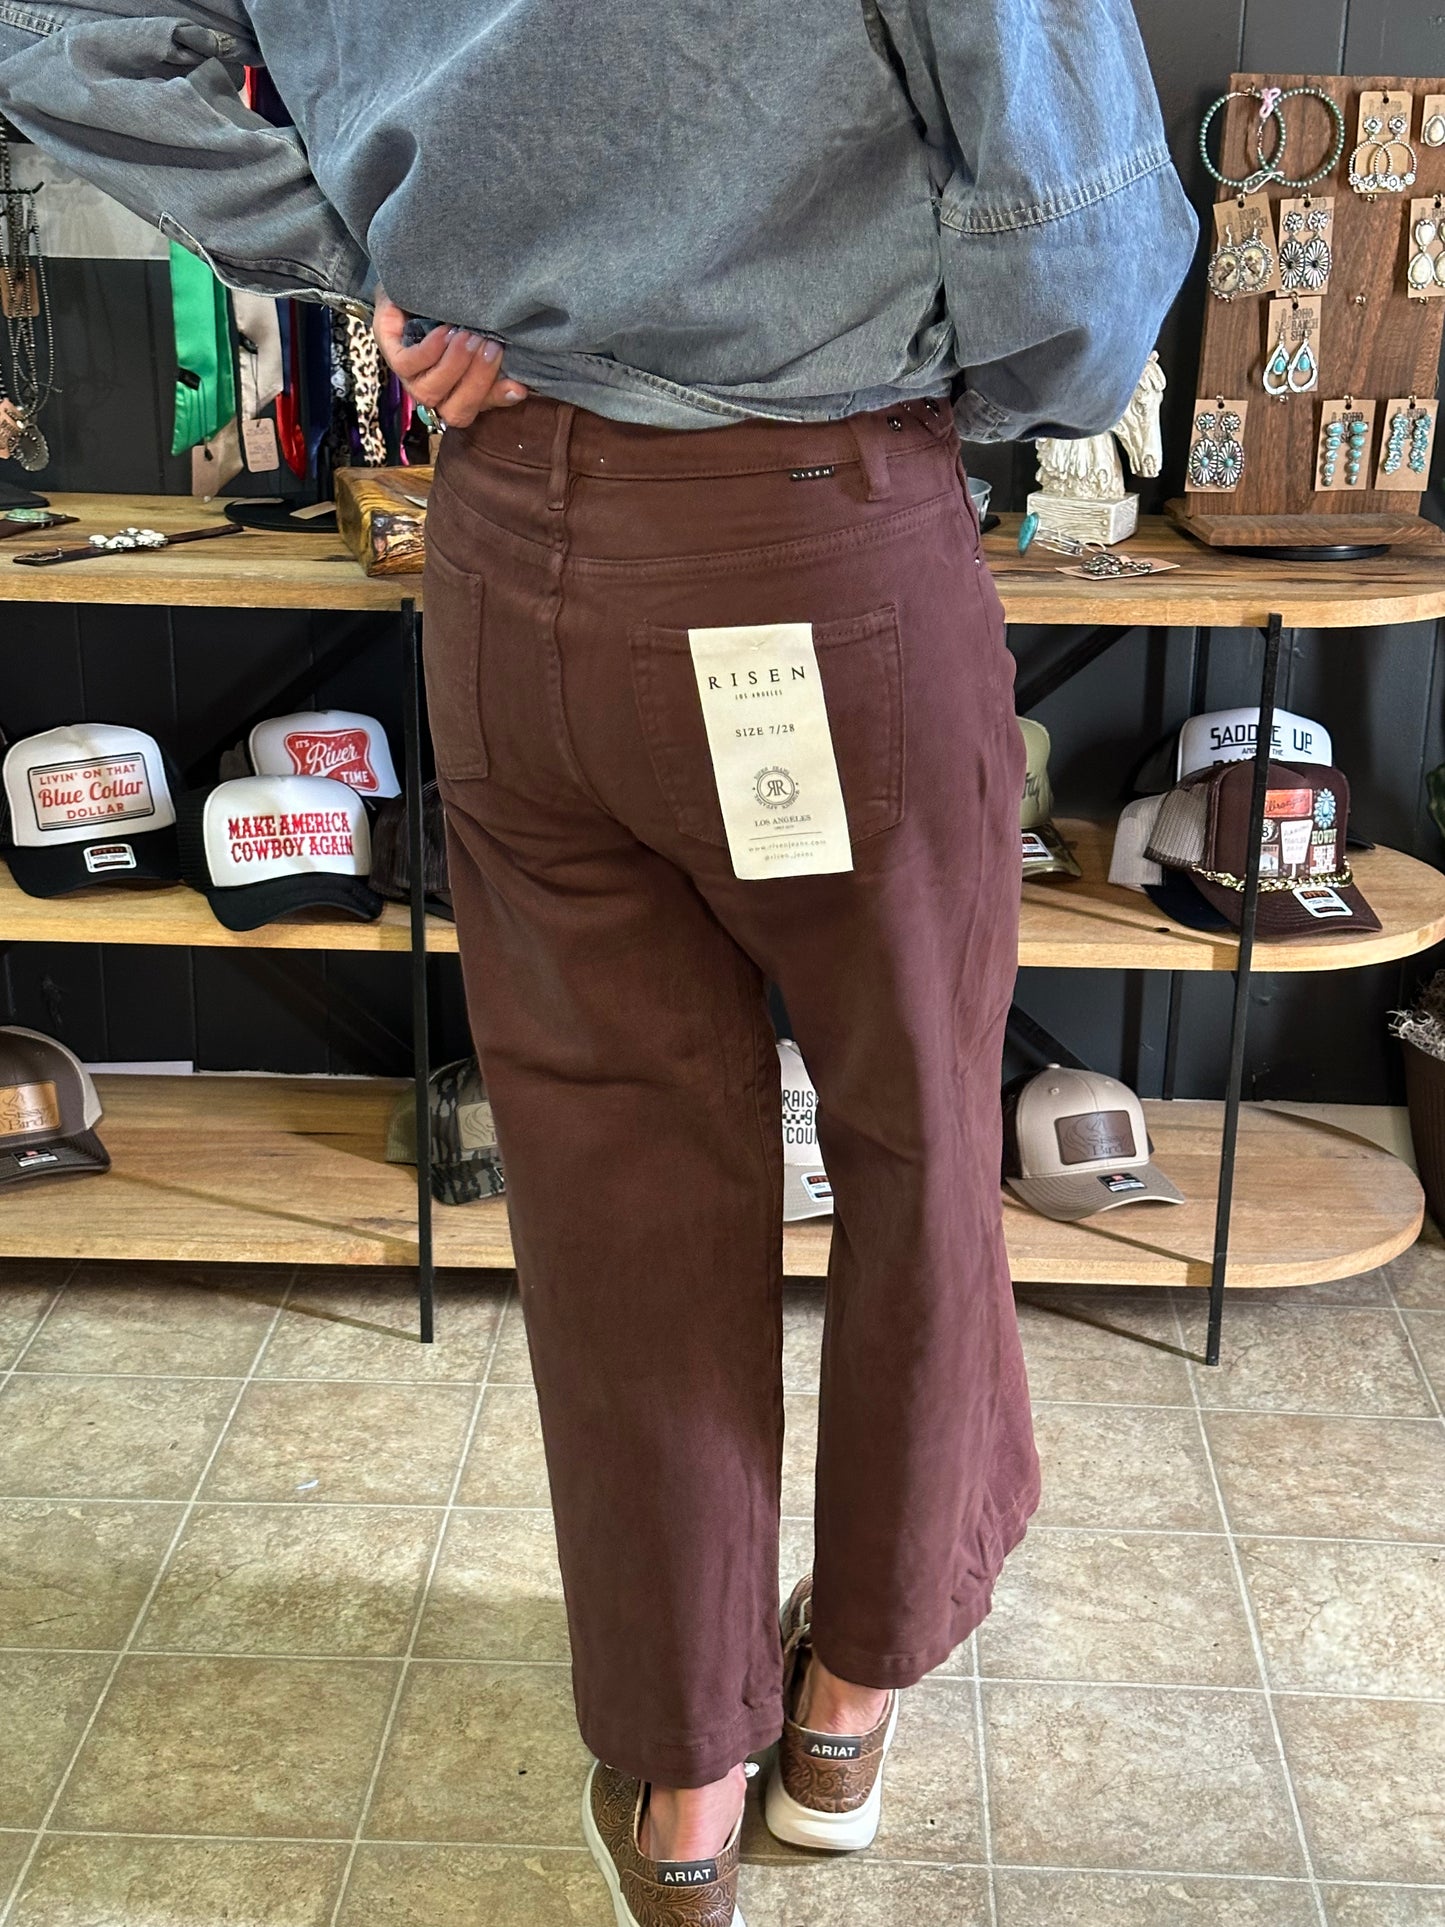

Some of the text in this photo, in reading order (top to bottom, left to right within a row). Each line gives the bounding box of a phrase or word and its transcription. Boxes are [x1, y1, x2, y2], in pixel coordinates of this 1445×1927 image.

[708, 666, 805, 690] RISEN
[735, 689, 783, 700] LOS ANGELES
[735, 723, 796, 738] SIZE 7/28
[1210, 724, 1313, 754] SADDE UP
[306, 741, 361, 777] River
[40, 764, 137, 786] LIVIN' ON THAT
[341, 770, 370, 783] TIME
[38, 779, 144, 808] Blue Collar
[66, 803, 125, 819] DOLLAR
[754, 818, 771, 828] LOS
[772, 814, 812, 825] ANGELES
[228, 812, 352, 840] MAKE AMERICA
[231, 835, 355, 863] COWBOY AGAIN
[782, 1089, 817, 1112] RAIS
[810, 1743, 856, 1757] ARIAT
[664, 1868, 712, 1882] ARIAT
